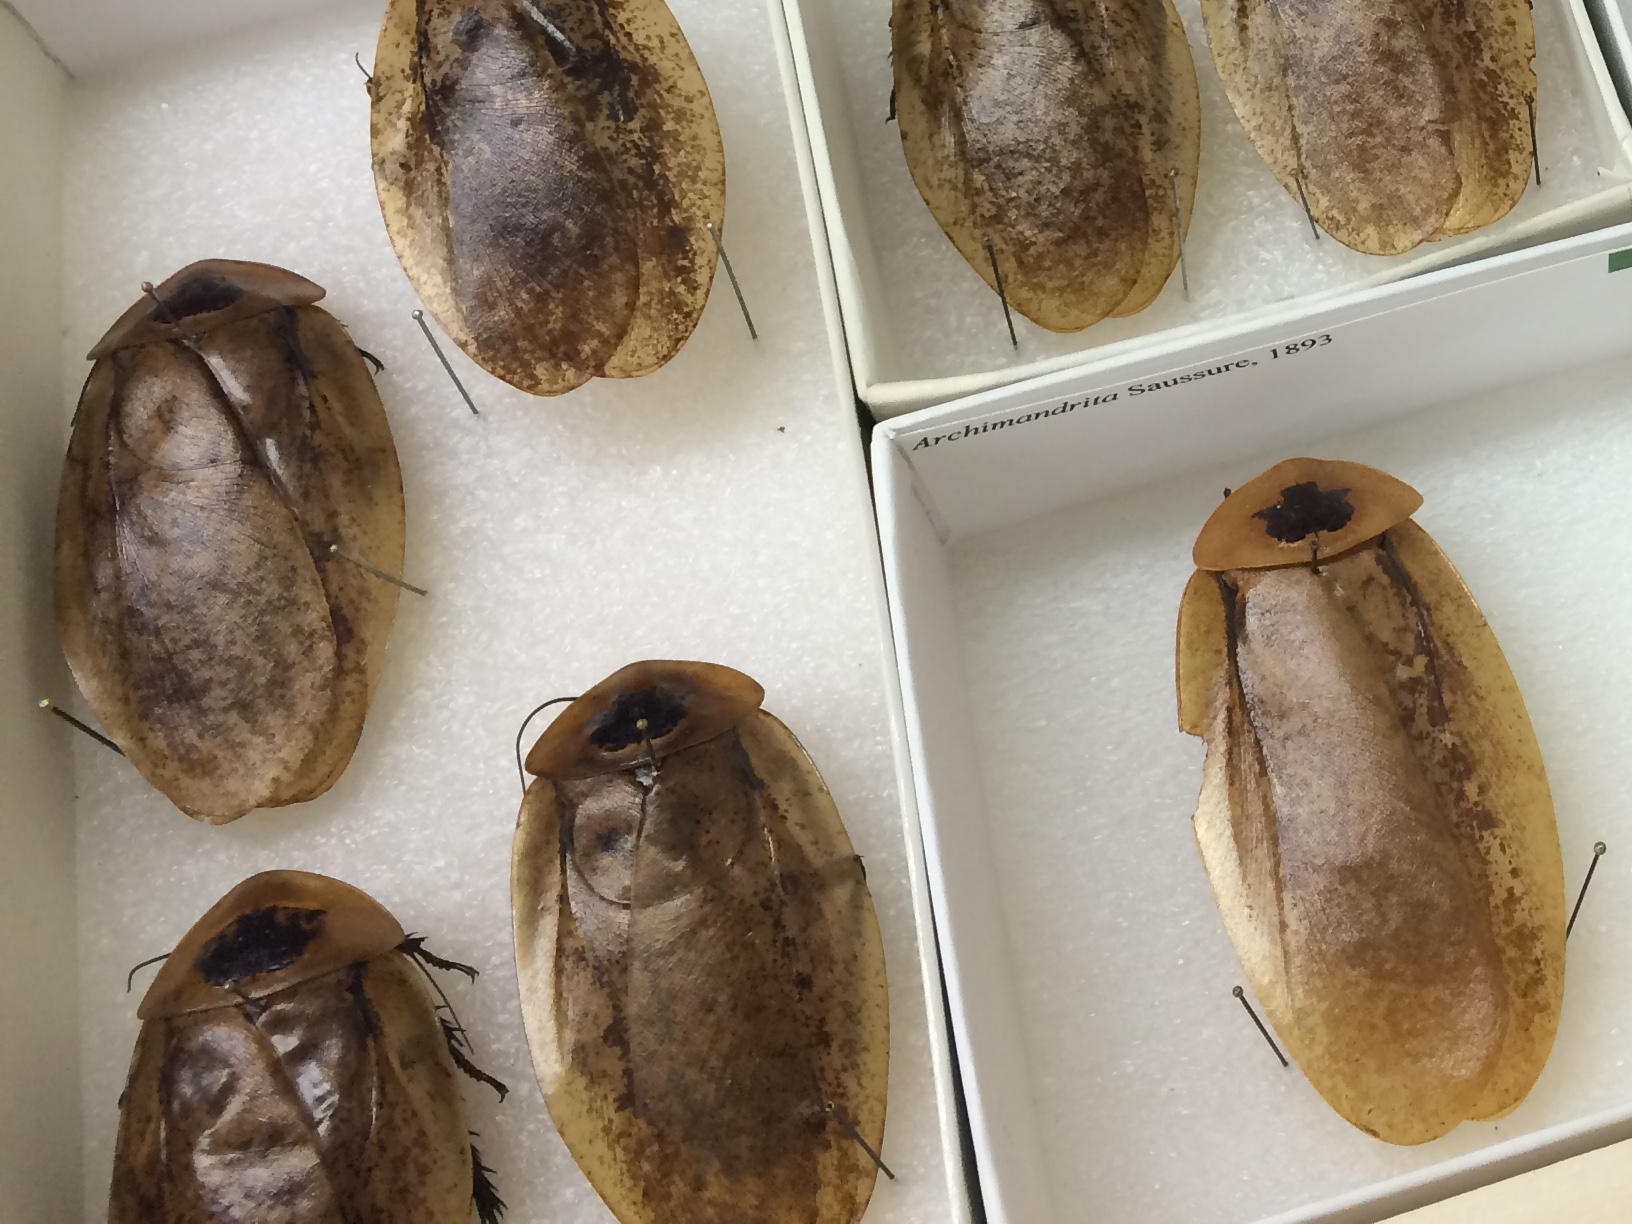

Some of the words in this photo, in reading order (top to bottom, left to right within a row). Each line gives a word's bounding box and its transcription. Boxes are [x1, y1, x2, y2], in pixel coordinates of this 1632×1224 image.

[912, 392, 1119, 451] Archimandrita
[1127, 358, 1258, 397] Saussure,
[1269, 334, 1333, 360] 1893
